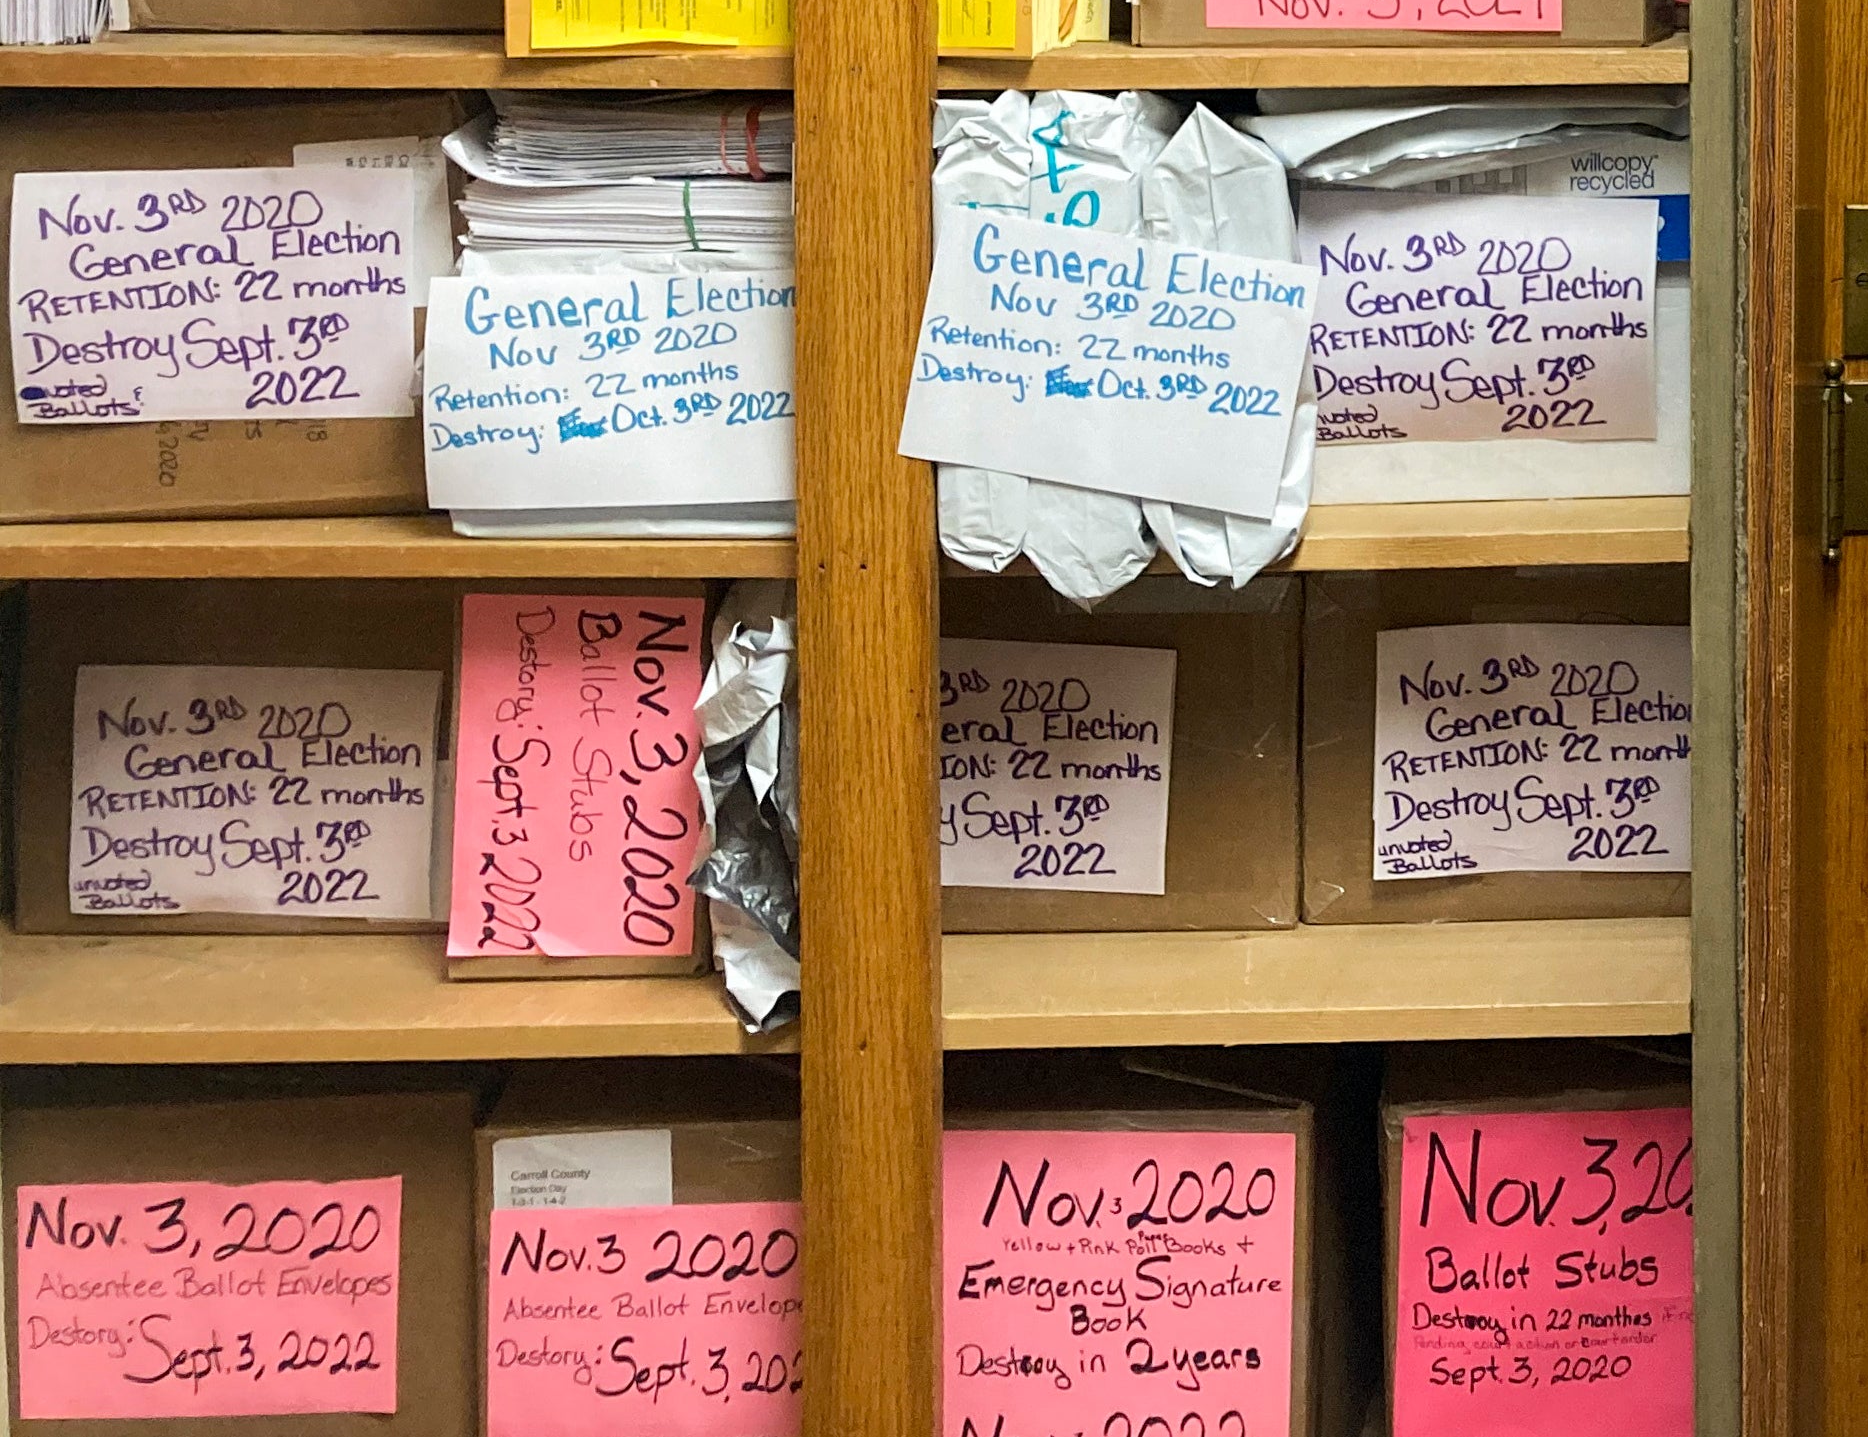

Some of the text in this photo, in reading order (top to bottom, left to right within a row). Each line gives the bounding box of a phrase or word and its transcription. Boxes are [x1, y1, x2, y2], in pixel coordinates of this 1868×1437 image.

[1569, 152, 1656, 192] willcopy recycled
[39, 196, 126, 240] Nov.
[220, 189, 324, 232] 2020
[69, 224, 402, 283] General Election
[1485, 316, 1533, 347] 22
[1540, 317, 1649, 342] months
[1398, 660, 1471, 706] Nov.
[1548, 660, 1641, 697] 2020
[566, 608, 625, 863] Ballot Stubs
[36, 1266, 394, 1305] Absentee Ballot Envelopes
[958, 1254, 1284, 1312] Emergency Signature
[1424, 1245, 1661, 1293] Ballot Stubs
[1069, 1304, 1149, 1335] Book
